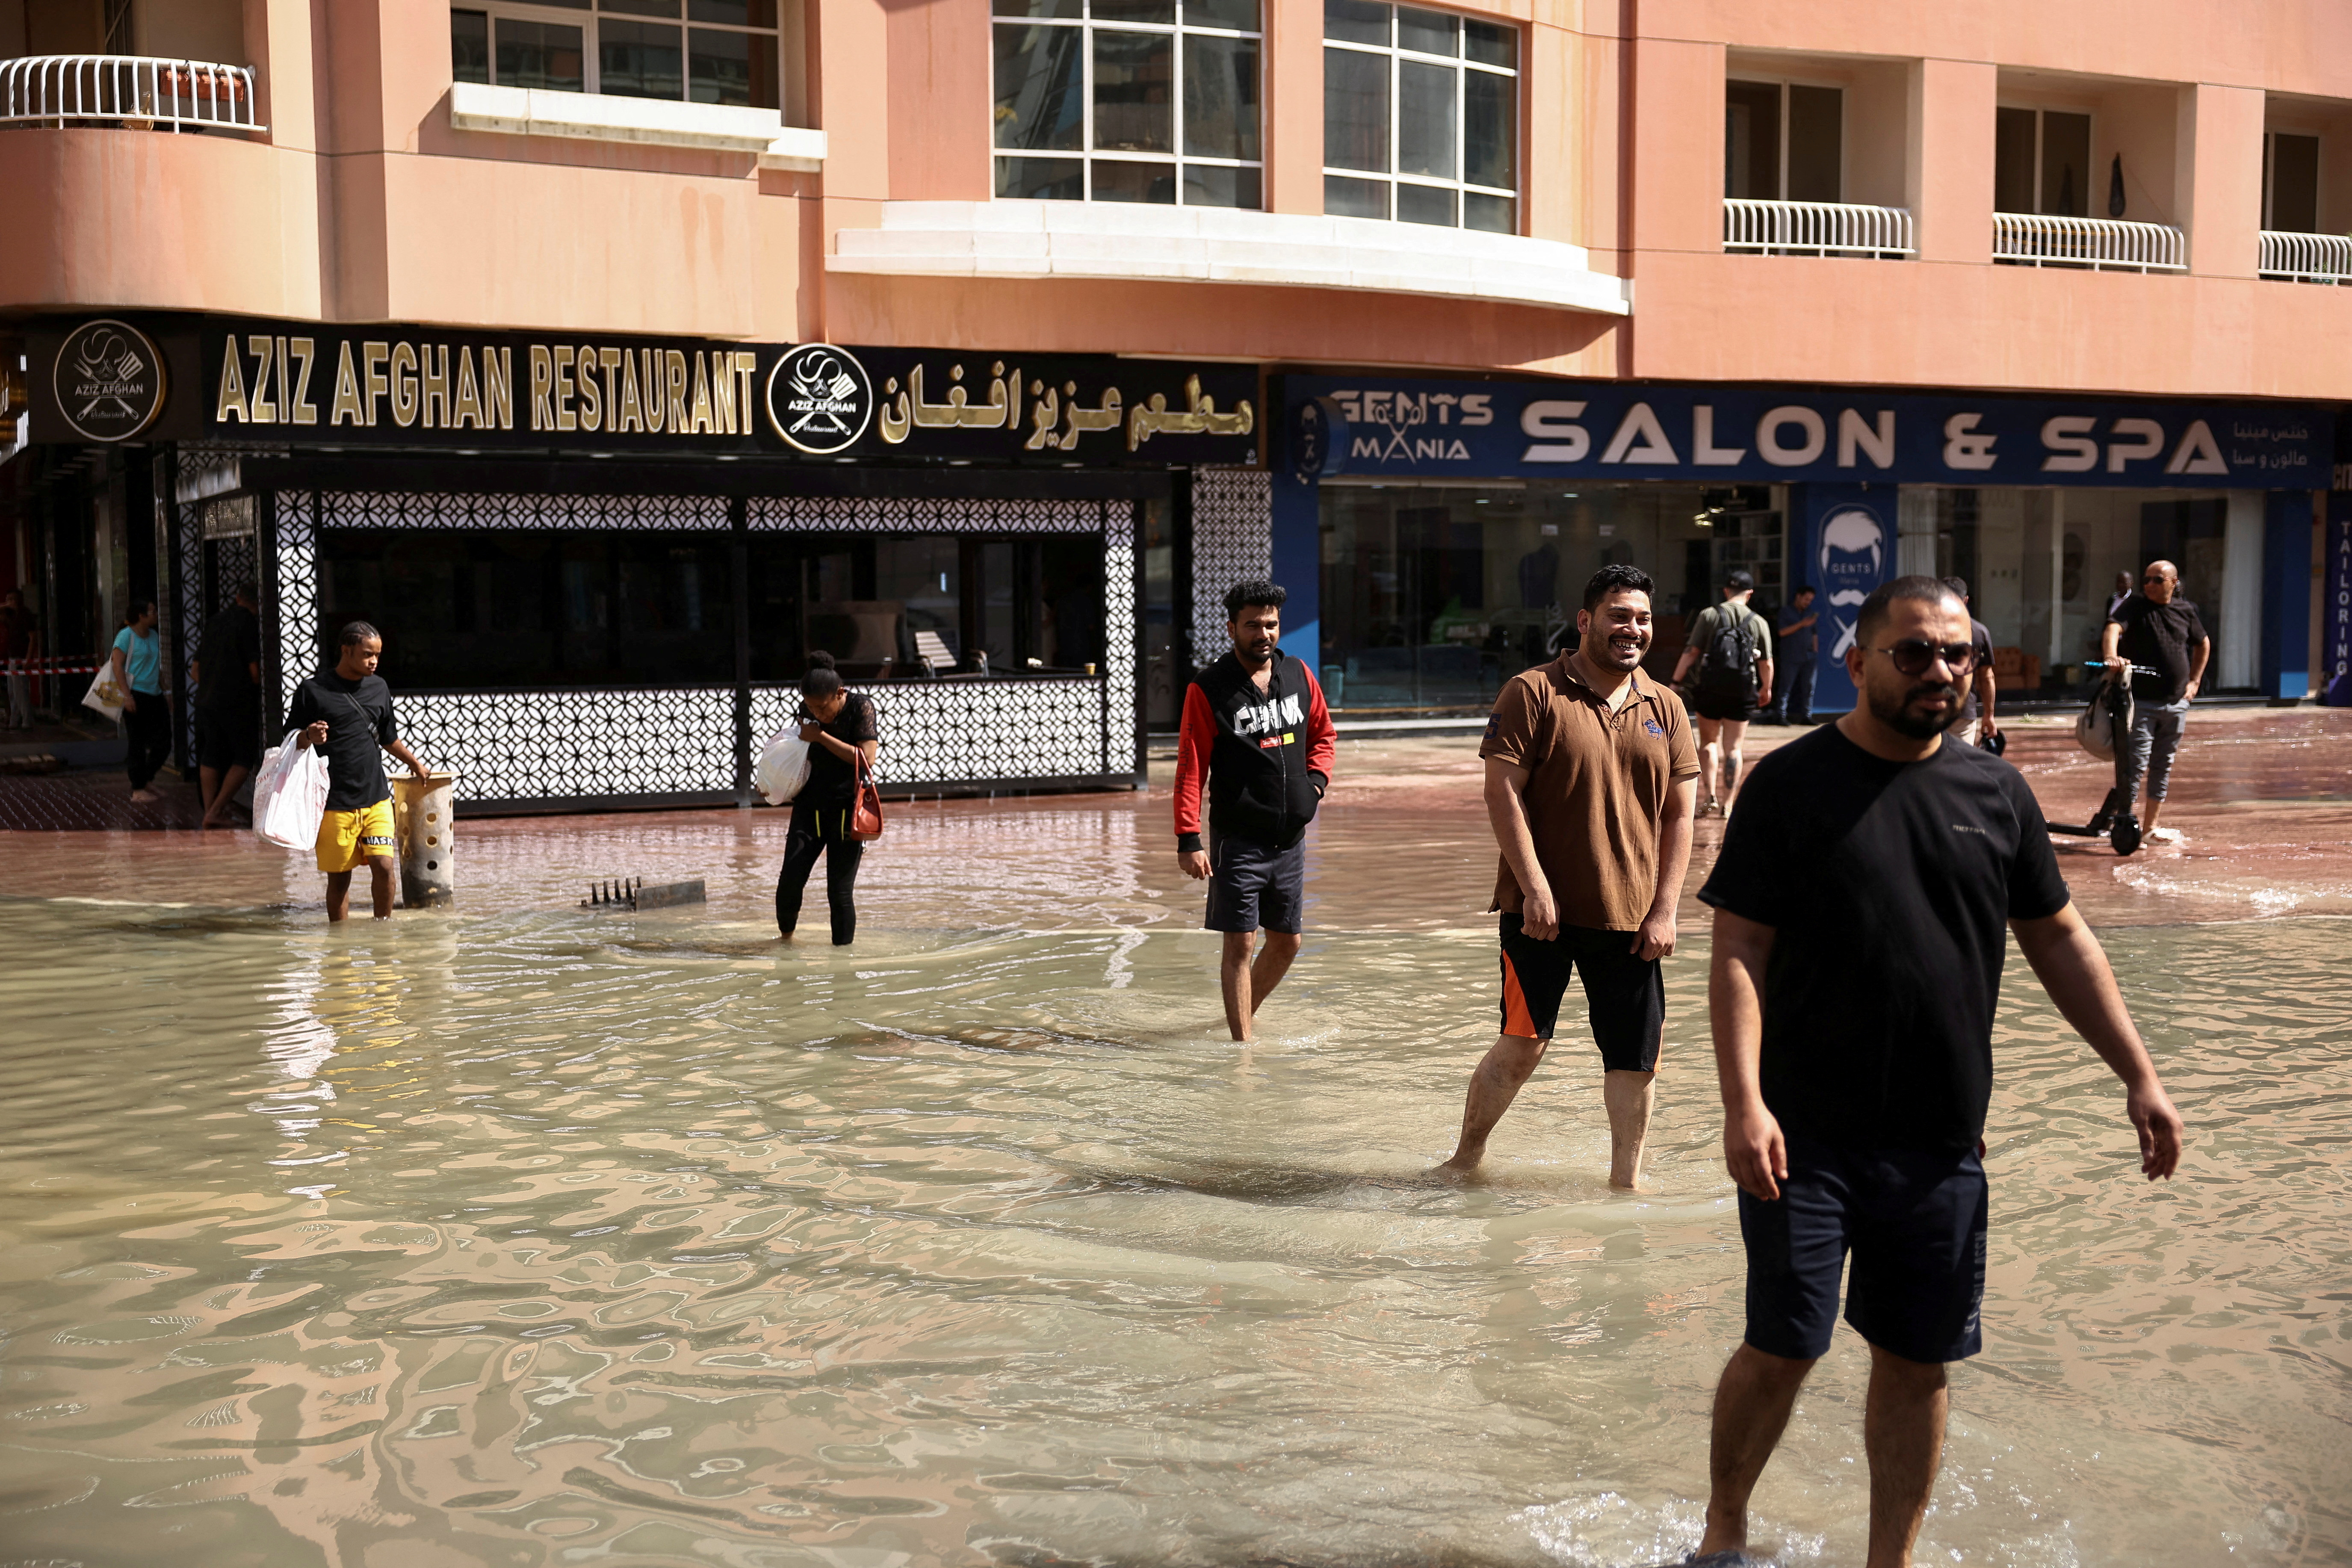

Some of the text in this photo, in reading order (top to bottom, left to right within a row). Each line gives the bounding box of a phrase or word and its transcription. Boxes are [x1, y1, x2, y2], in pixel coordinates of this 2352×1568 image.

[75, 383, 143, 396] AZIZ AFGHAN
[217, 334, 756, 435] AZIZ AFGHAN RESTAURANT
[788, 400, 857, 413] AZIZ AFGHAN
[1025, 379, 1123, 450] عزيز
[1129, 373, 1253, 452] مطعم
[1329, 390, 1493, 425] GENTS
[1350, 436, 1471, 464] MANIA
[1519, 399, 2230, 475] SALON & SPA
[1831, 563, 1870, 574] GENTS
[2336, 520, 2351, 676] TAILORING
[1484, 713, 1502, 739] 5
